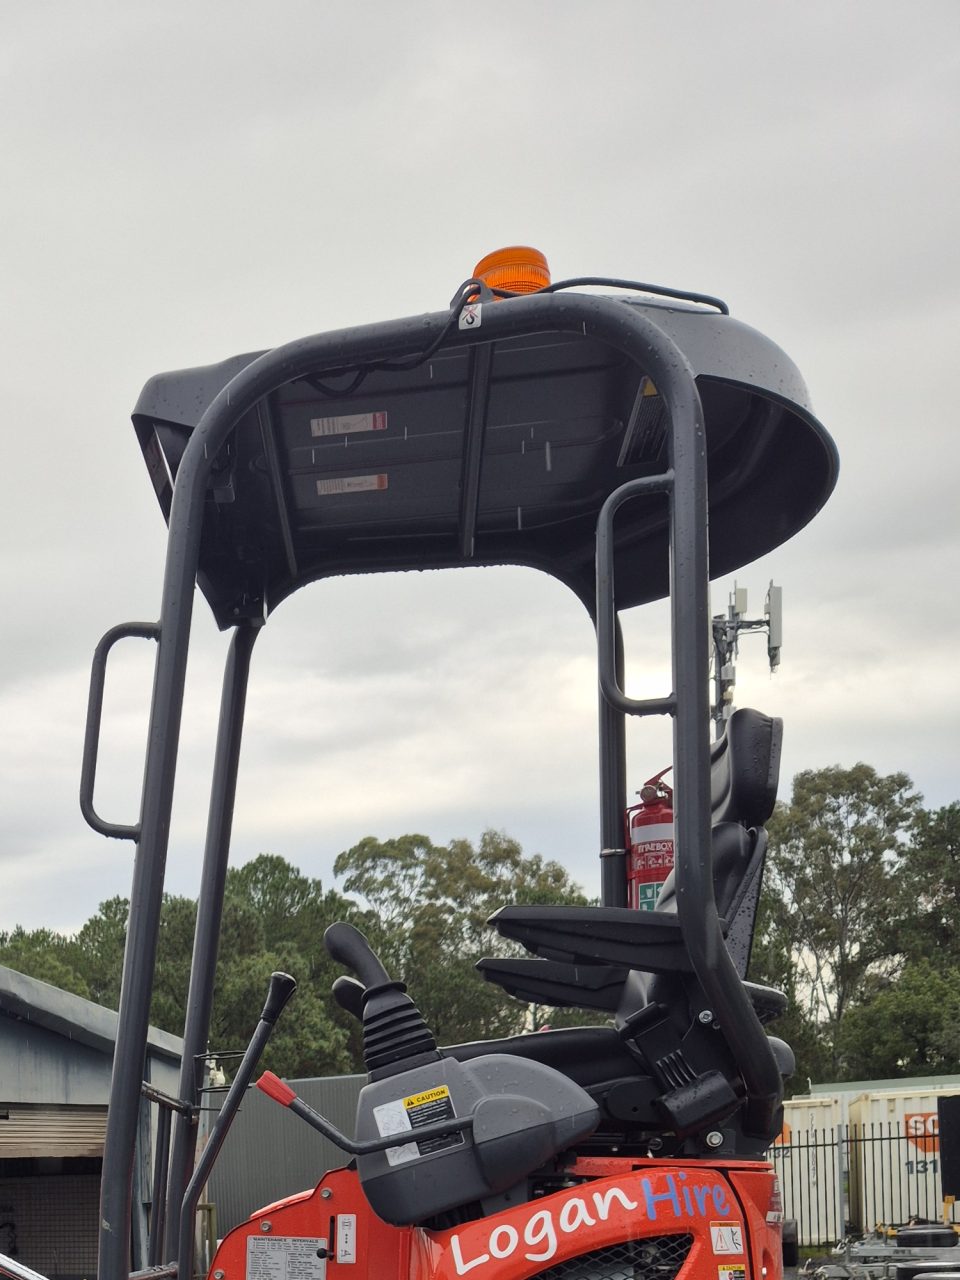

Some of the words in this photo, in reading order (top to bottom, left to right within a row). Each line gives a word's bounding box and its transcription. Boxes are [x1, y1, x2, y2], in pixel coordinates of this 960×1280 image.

[416, 1089, 446, 1103] CAUTION
[450, 1187, 638, 1276] Logan
[642, 1172, 731, 1221] Hire
